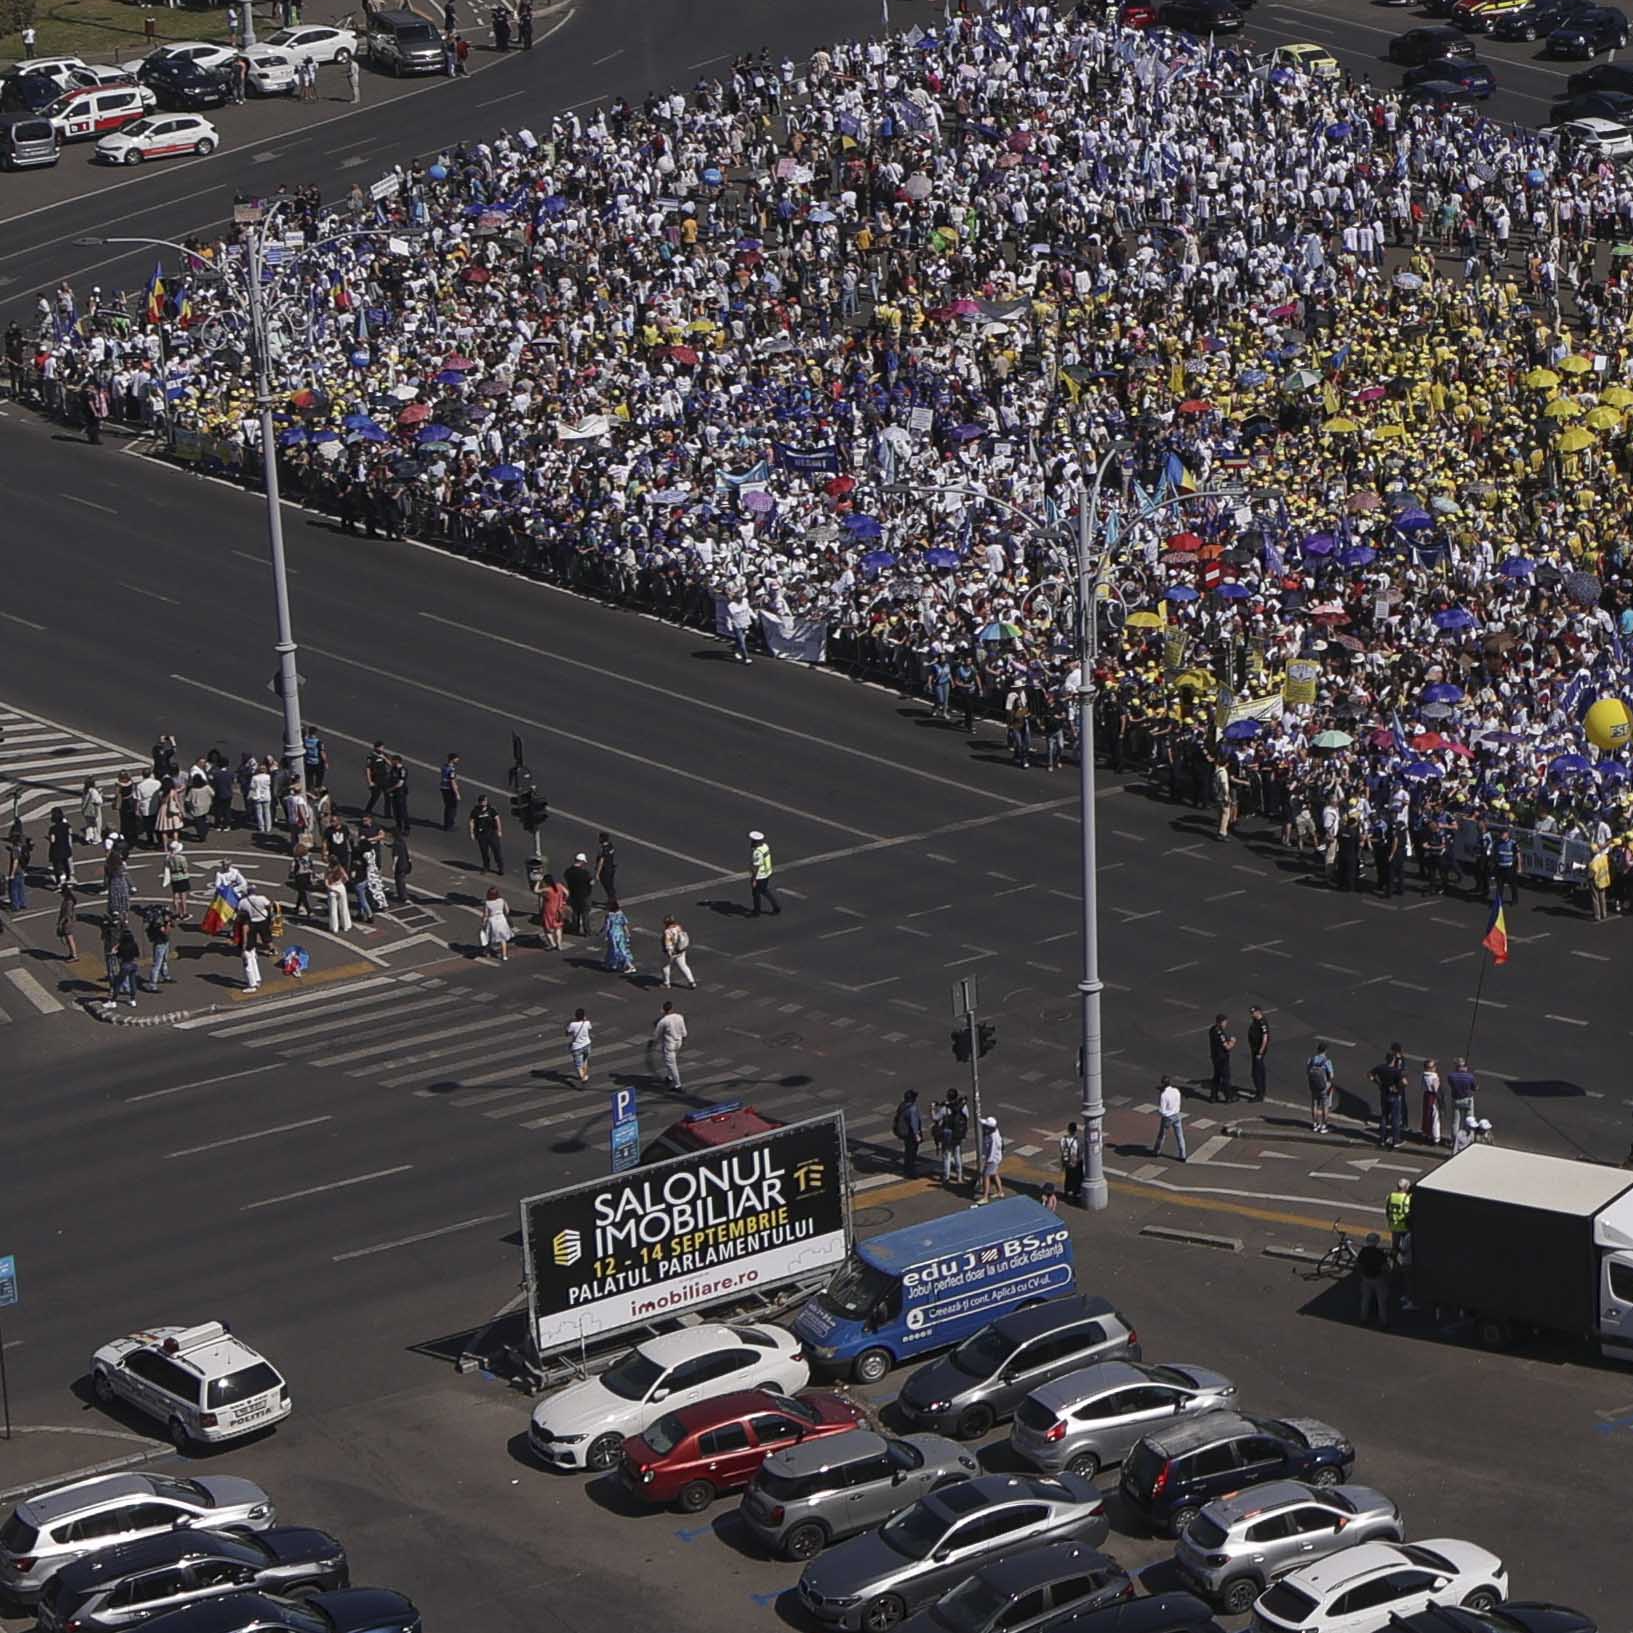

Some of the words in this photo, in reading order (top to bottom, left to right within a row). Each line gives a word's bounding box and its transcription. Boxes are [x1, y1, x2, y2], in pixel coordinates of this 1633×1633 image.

[617, 1090, 630, 1120] P
[594, 1148, 785, 1226] SALONUL
[595, 1178, 786, 1258] IMOBILIAR
[569, 1267, 652, 1305] PALATUL
[659, 1218, 814, 1276] PARLAMENTULUI
[593, 1257, 616, 1278] 12
[640, 1243, 663, 1266] 14
[671, 1207, 790, 1256] SEPTEMBRIE
[631, 1269, 759, 1316] imobiliare.ro
[934, 1273, 965, 1295] perfect
